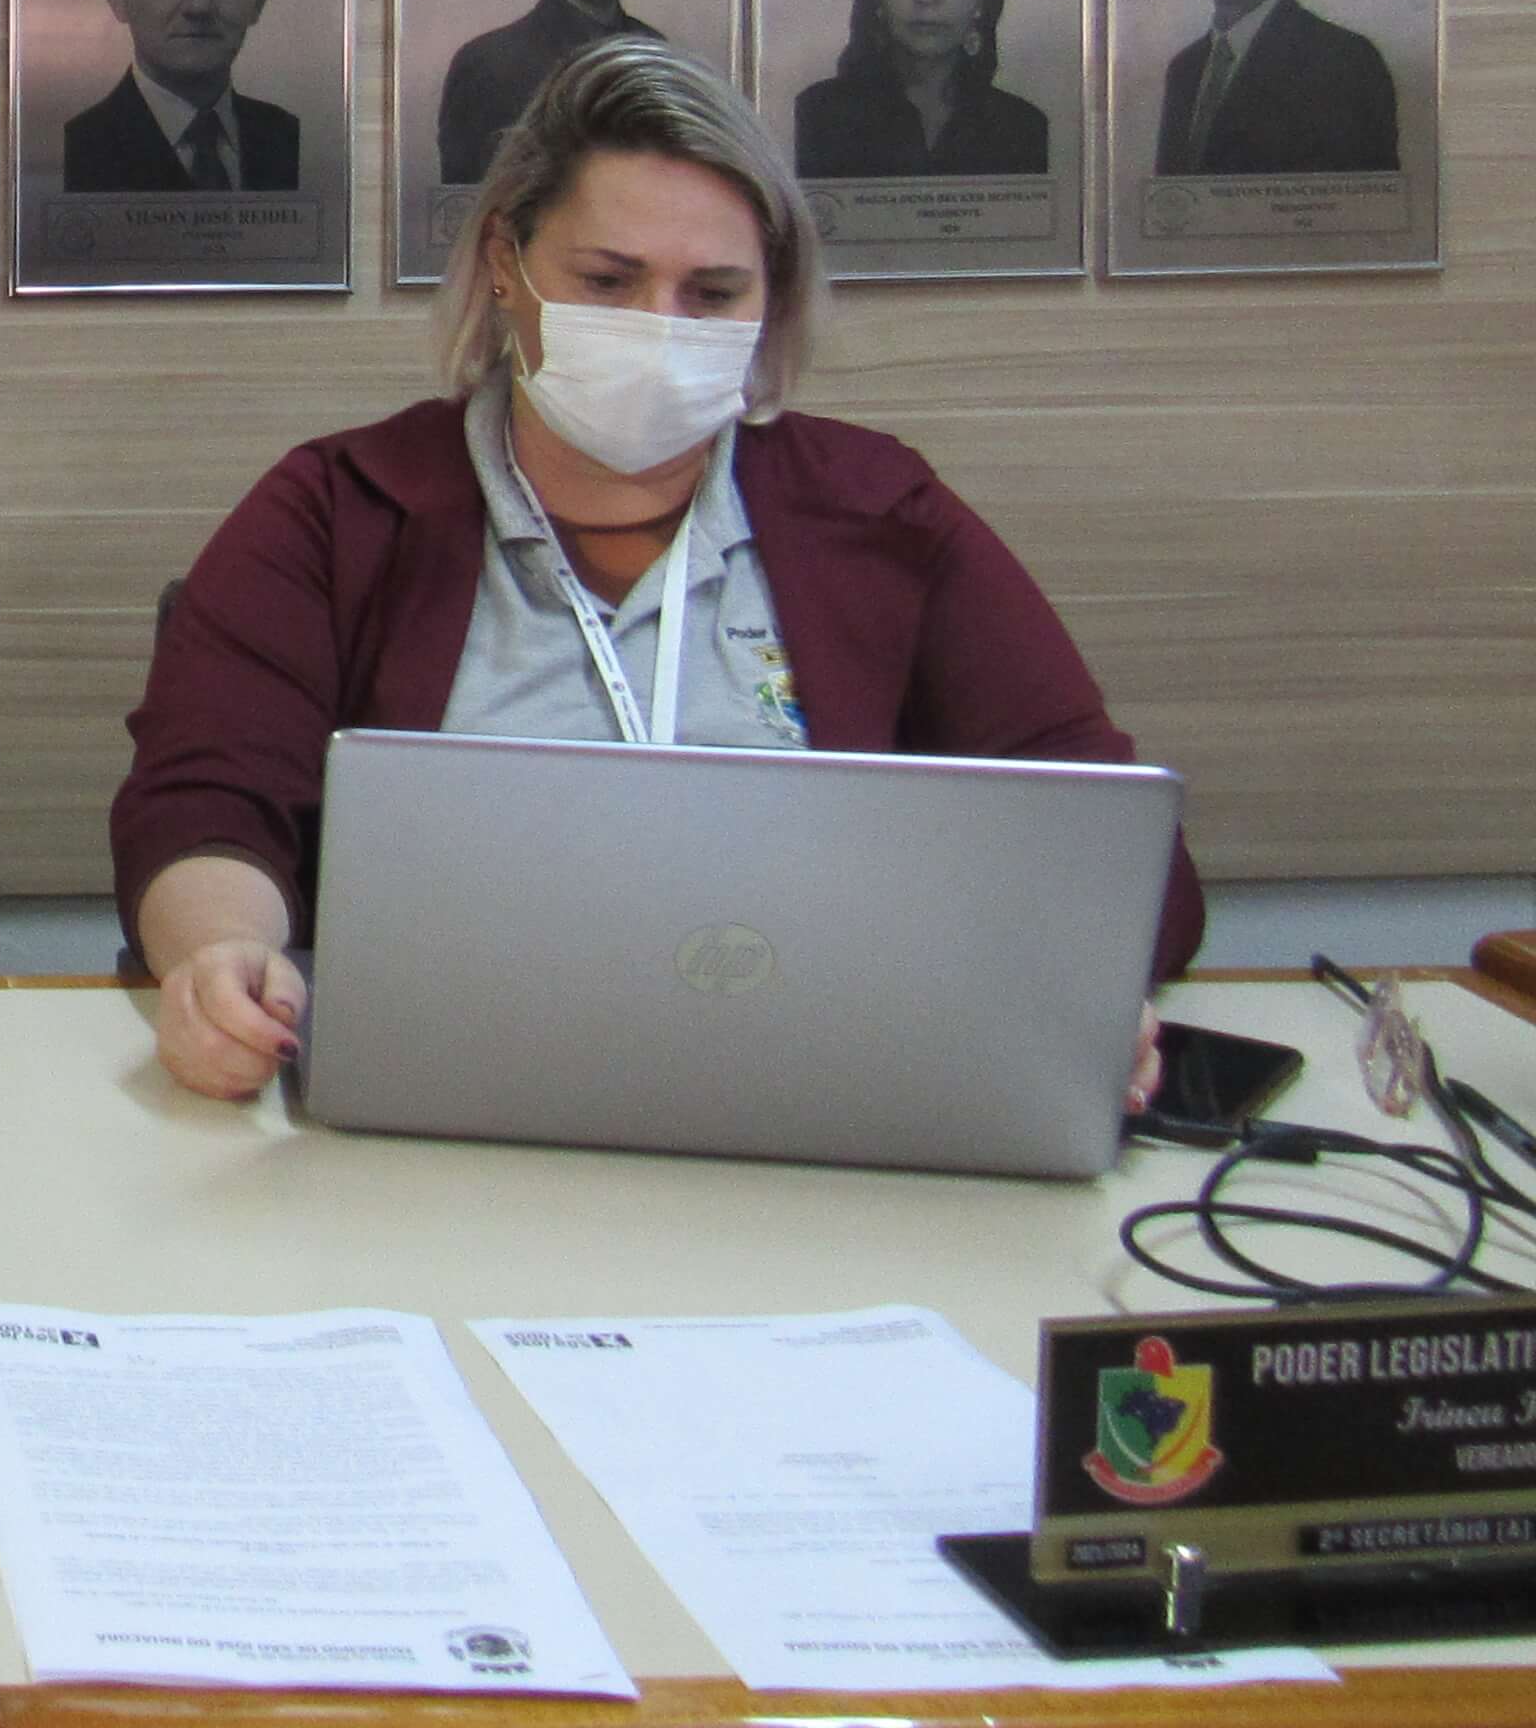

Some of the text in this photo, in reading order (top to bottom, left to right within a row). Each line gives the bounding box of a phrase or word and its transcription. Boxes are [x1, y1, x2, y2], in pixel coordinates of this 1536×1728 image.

[725, 626, 767, 640] Poder
[1252, 1332, 1536, 1385] PODER LEGISLATI
[1350, 1520, 1489, 1549] SECRETÁRIO
